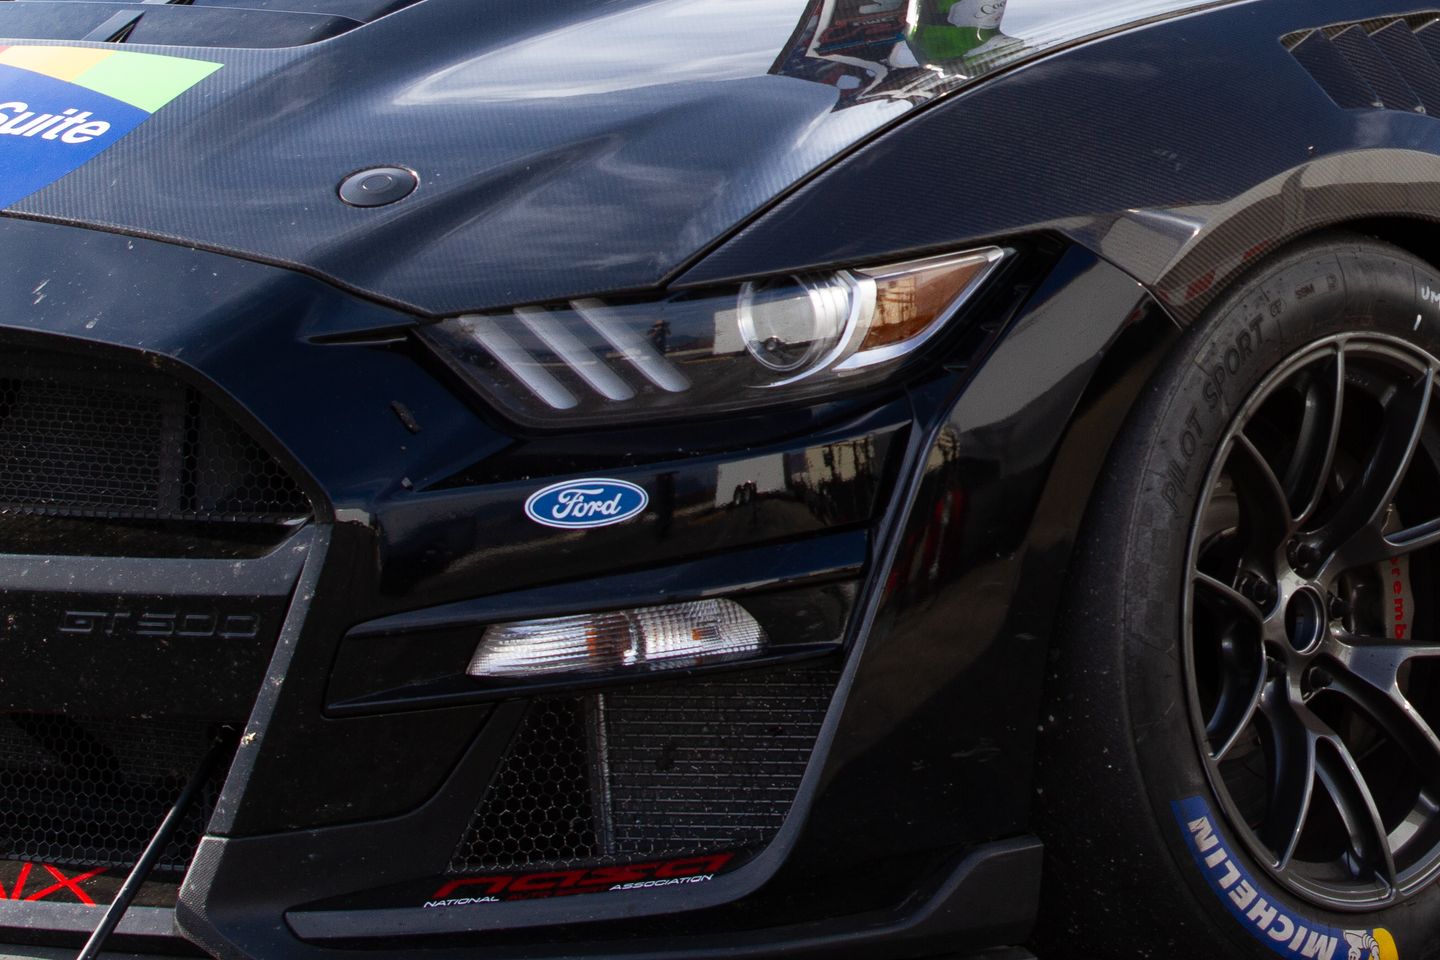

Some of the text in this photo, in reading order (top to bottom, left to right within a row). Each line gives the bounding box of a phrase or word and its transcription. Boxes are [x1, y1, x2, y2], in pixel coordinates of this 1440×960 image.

[0, 101, 110, 144] Suite
[1162, 314, 1264, 512] PILOT SPORT
[552, 488, 622, 518] Ford
[1391, 557, 1407, 639] remb
[59, 610, 259, 637] GT500
[432, 853, 734, 898] nasa
[609, 874, 713, 891] ASSOCIATION
[1187, 816, 1338, 960] MICHELIN
[424, 896, 499, 908] NATIONAL
